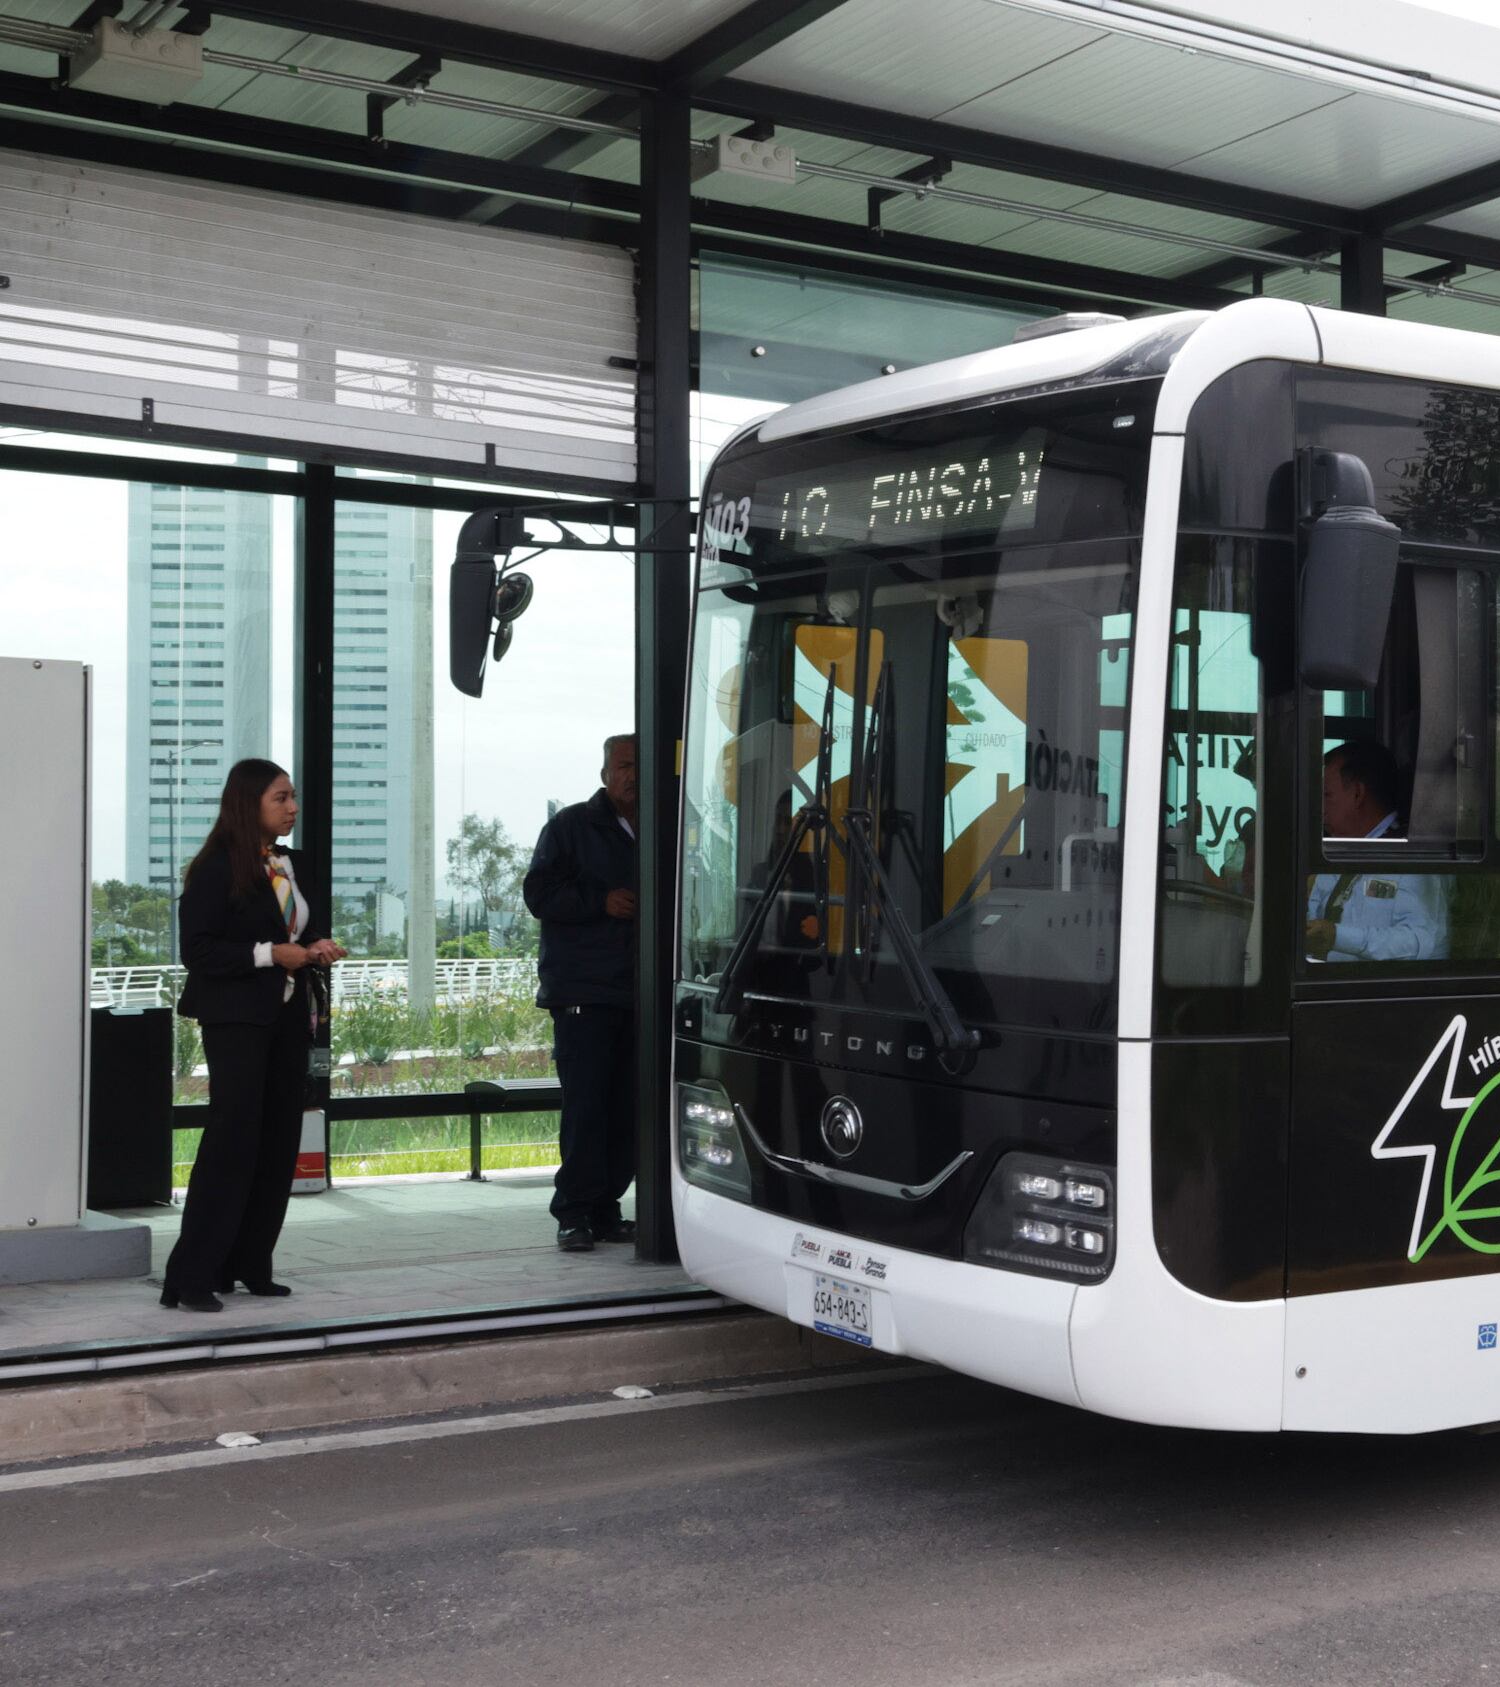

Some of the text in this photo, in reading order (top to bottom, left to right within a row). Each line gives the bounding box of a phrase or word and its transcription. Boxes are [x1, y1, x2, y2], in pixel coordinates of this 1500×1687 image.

[769, 1023, 926, 1060] YUTONG
[828, 1255, 852, 1269] PUEBLA
[814, 1291, 868, 1328] 654-843-S
